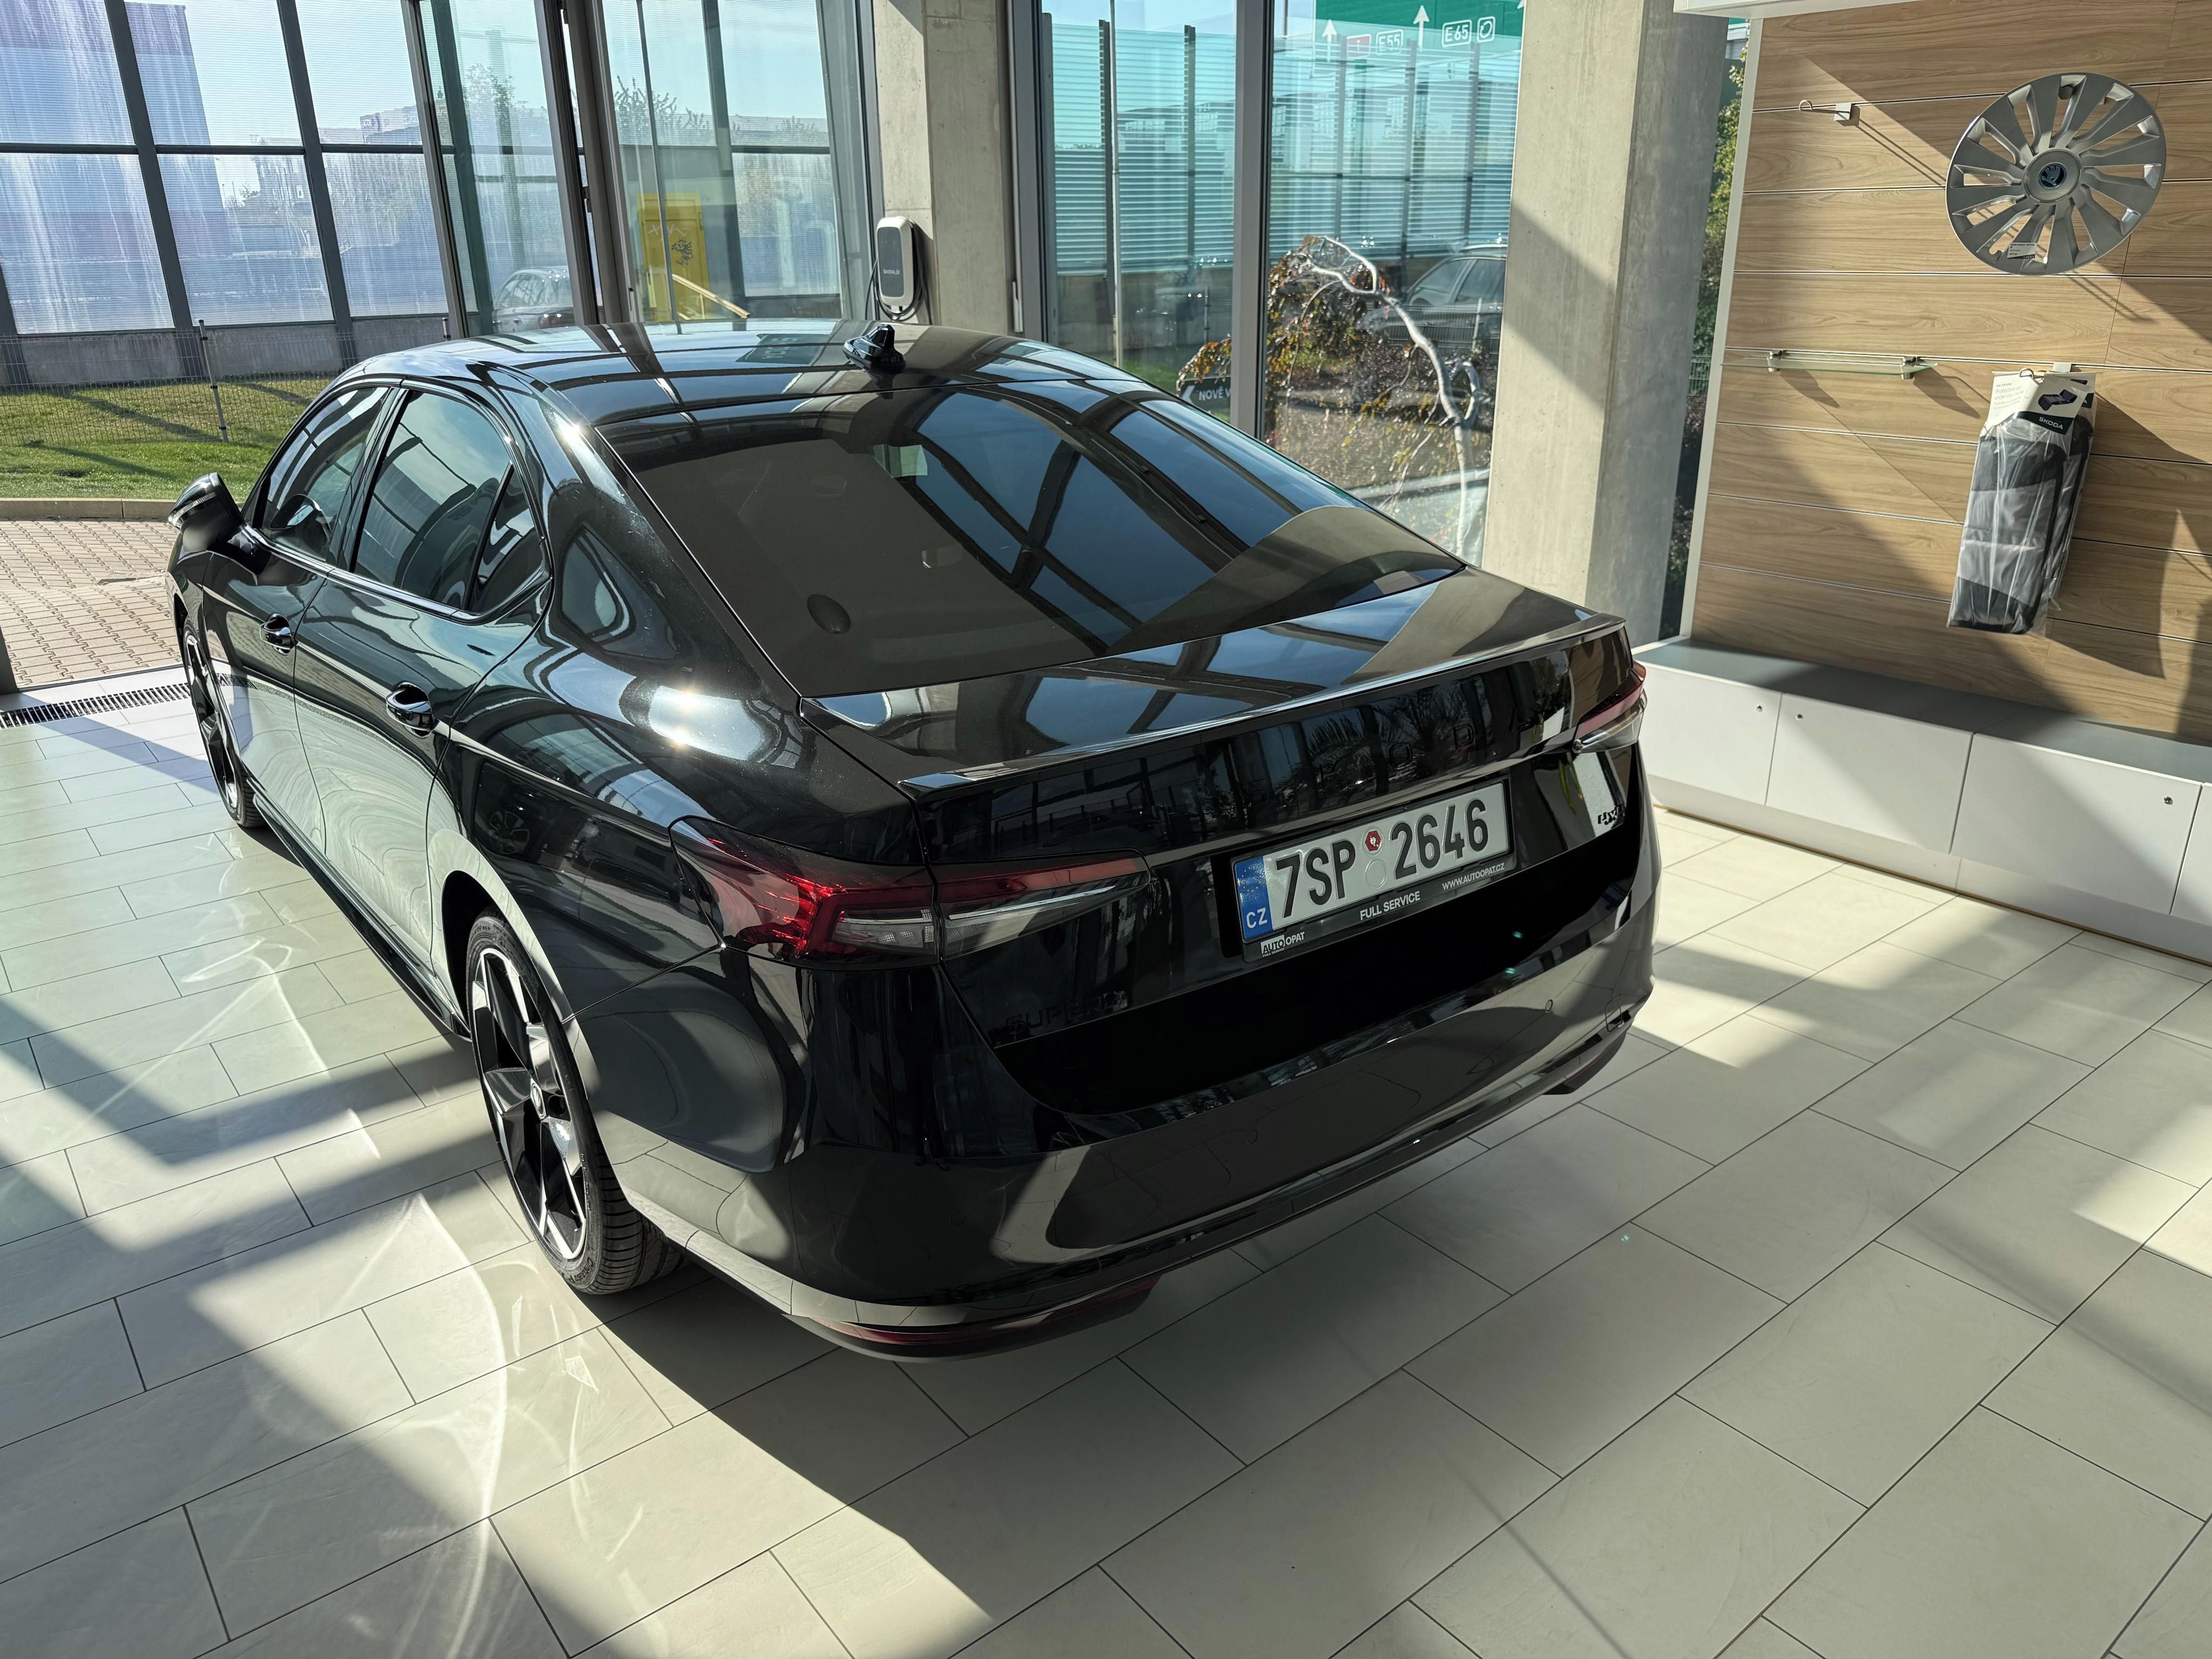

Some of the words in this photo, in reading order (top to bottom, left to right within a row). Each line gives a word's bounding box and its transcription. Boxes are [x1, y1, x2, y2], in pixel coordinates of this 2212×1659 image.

[1276, 840, 1355, 918] 7SP
[1390, 799, 1488, 880] 2646
[1442, 862, 1505, 890] WWW.AUTOOPAT.CZ
[1246, 907, 1267, 928] CZ
[1360, 905, 1382, 920] FULL
[1383, 891, 1420, 912] SERVICE
